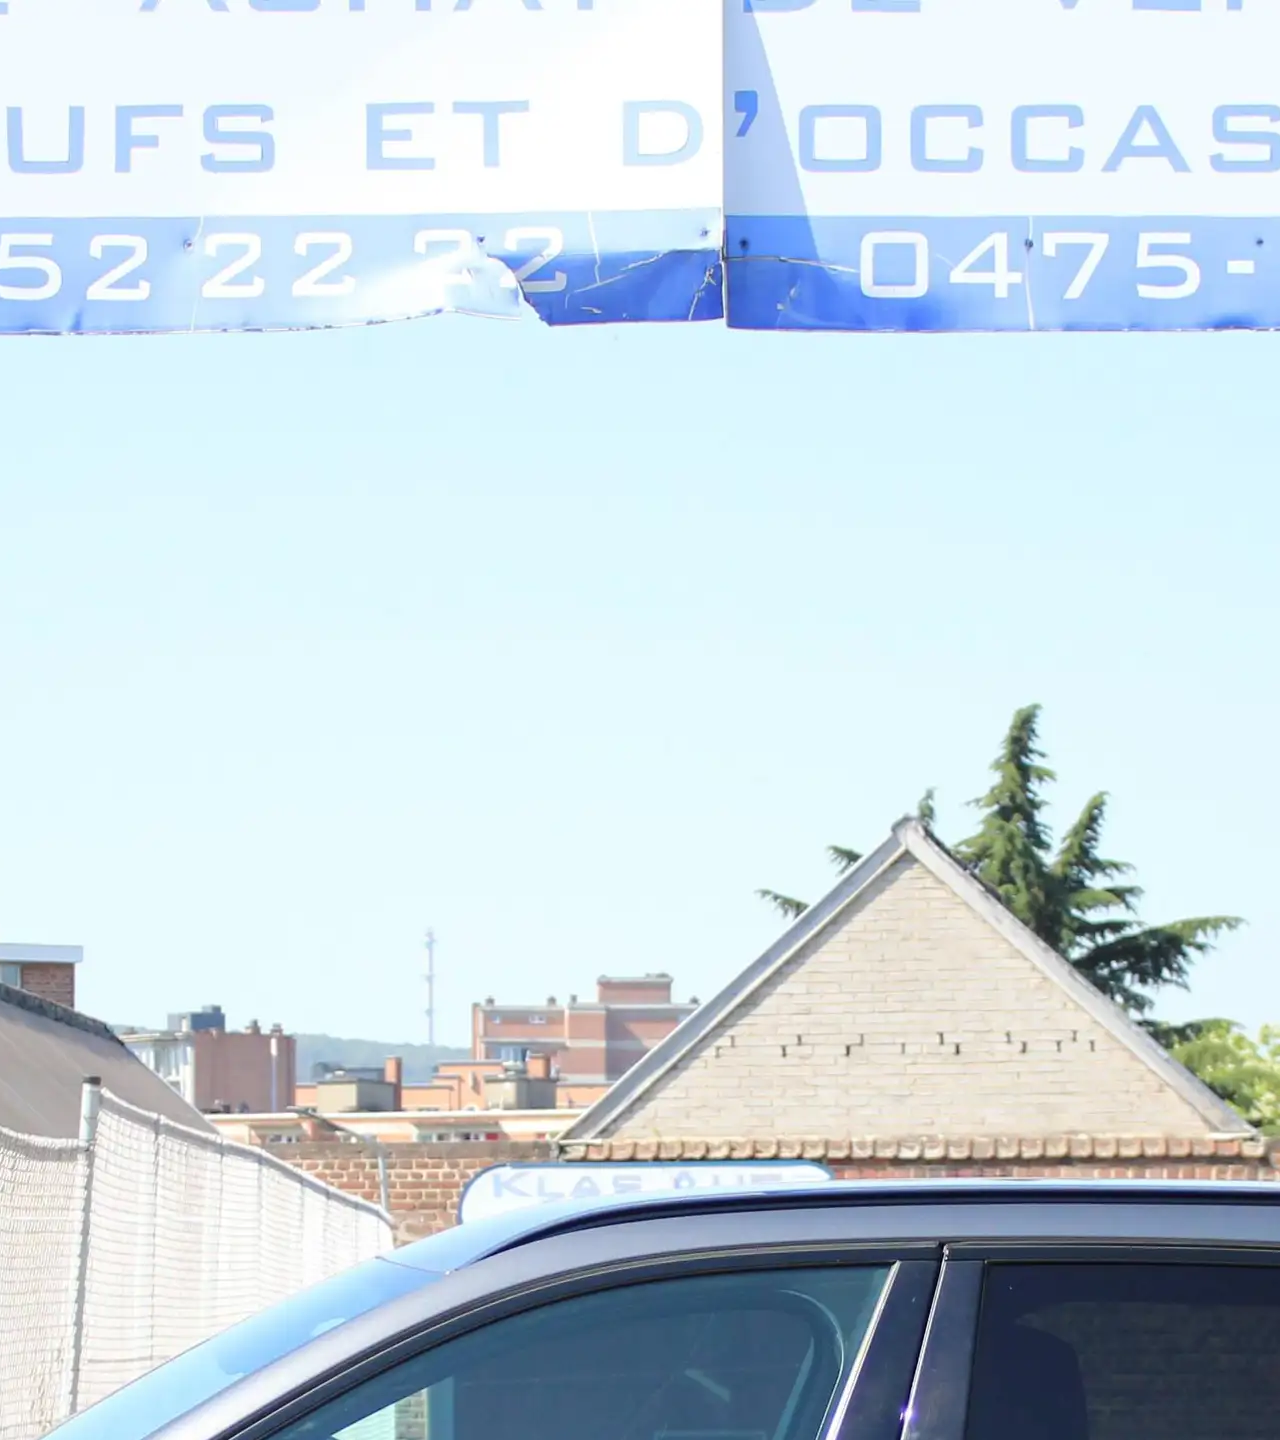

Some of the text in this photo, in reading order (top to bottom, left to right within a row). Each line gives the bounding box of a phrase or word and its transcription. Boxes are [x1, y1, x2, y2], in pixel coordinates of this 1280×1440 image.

[364, 100, 531, 170] ET
[201, 231, 357, 299] 22
[413, 226, 568, 292] 22
[492, 1170, 642, 1198] KLAS
